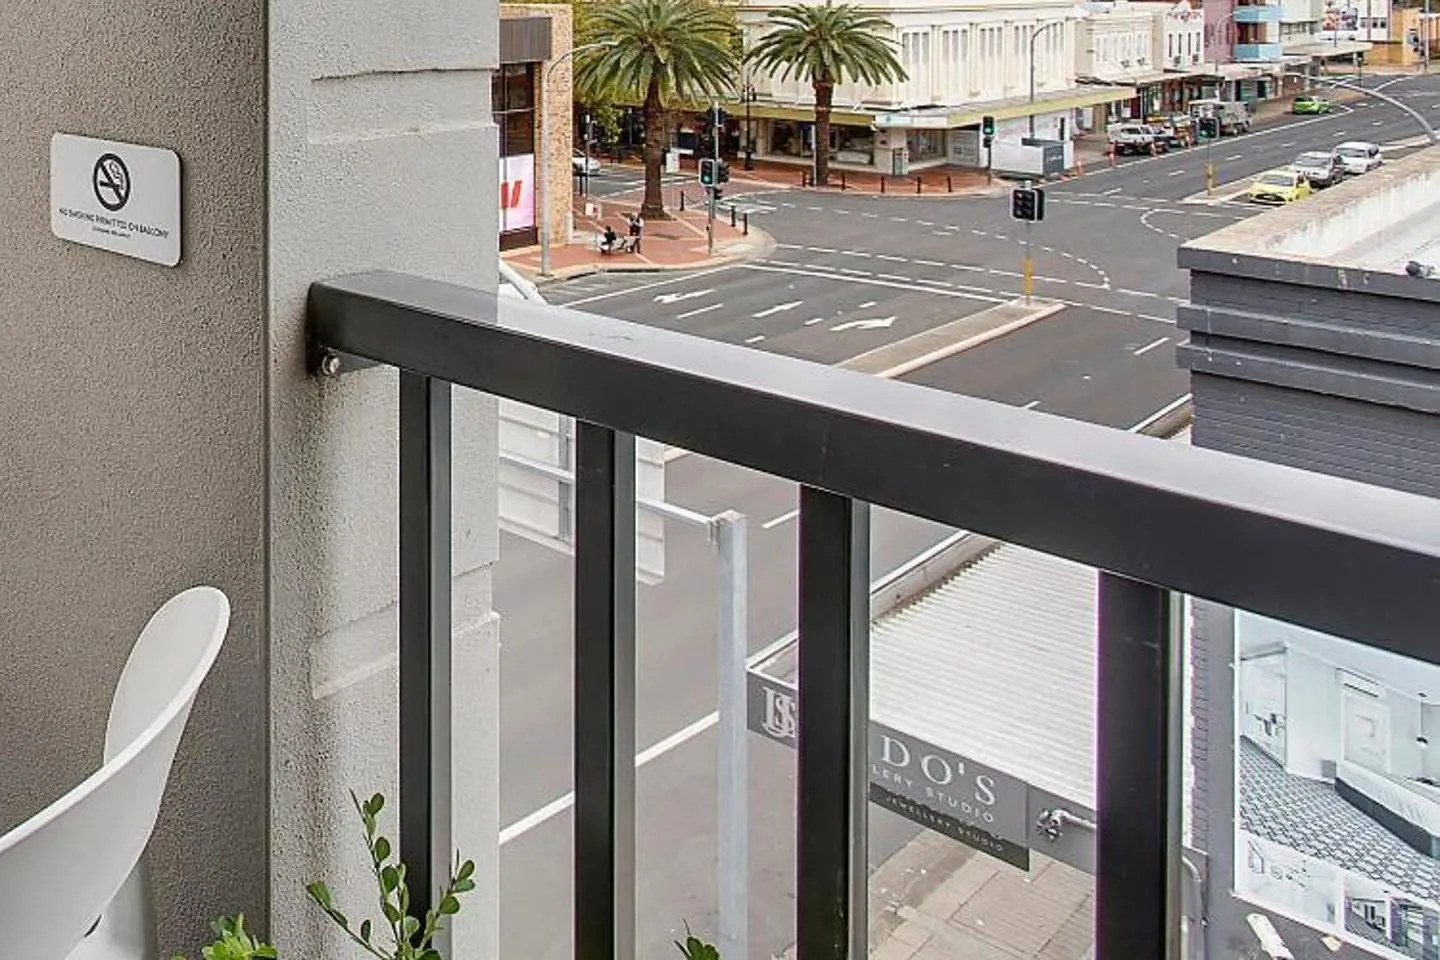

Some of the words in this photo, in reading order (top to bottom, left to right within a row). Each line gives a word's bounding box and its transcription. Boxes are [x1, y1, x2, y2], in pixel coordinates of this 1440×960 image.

[872, 764, 912, 788] LERY
[926, 787, 994, 822] STUDIO
[881, 735, 996, 805] DO'S
